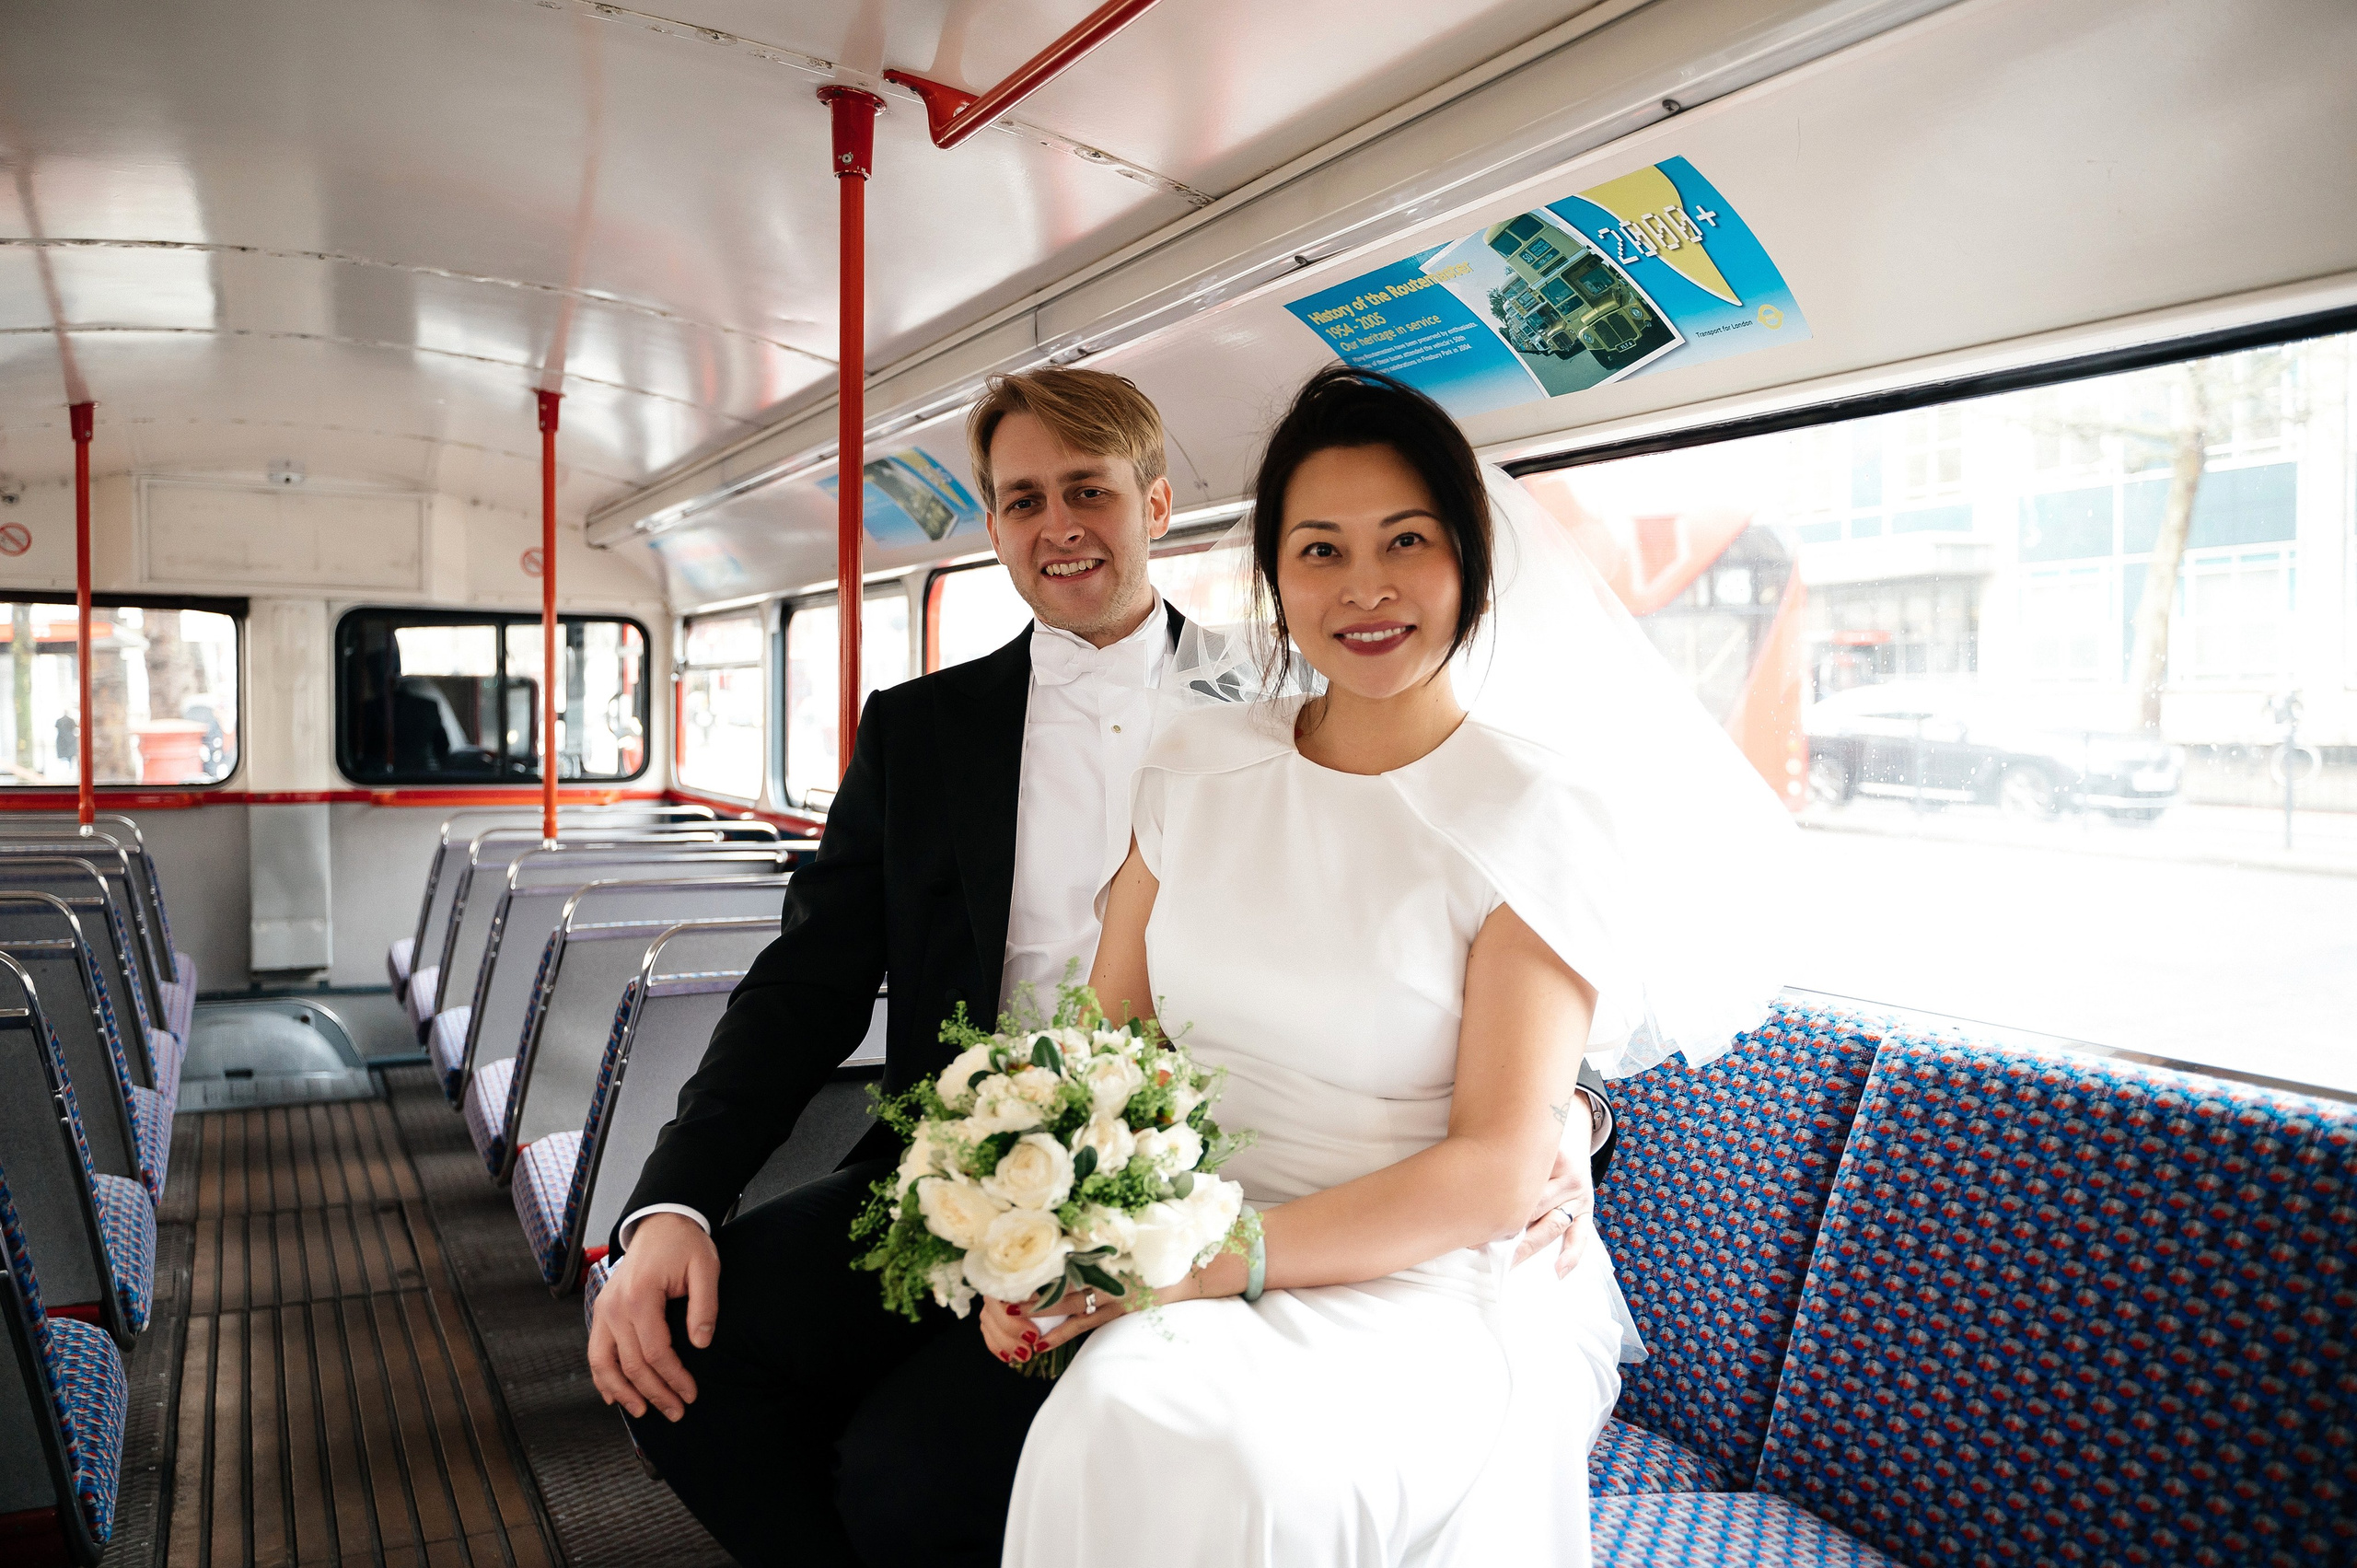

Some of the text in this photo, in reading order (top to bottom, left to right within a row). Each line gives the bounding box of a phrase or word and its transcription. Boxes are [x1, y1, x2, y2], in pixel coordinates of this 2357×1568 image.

[1307, 261, 1473, 325] History of the Routemaster
[1326, 322, 1354, 340] 1954
[1355, 311, 1387, 330] 2005
[1340, 314, 1442, 352] Our heritage in service
[1695, 326, 1723, 339] Transport
[1730, 319, 1754, 330] London
[1402, 347, 1424, 358] attended
[1432, 338, 1455, 349] vehicle's
[1452, 334, 1467, 343] 50th
[1417, 331, 1442, 345] preserved
[1440, 347, 1454, 357] Park
